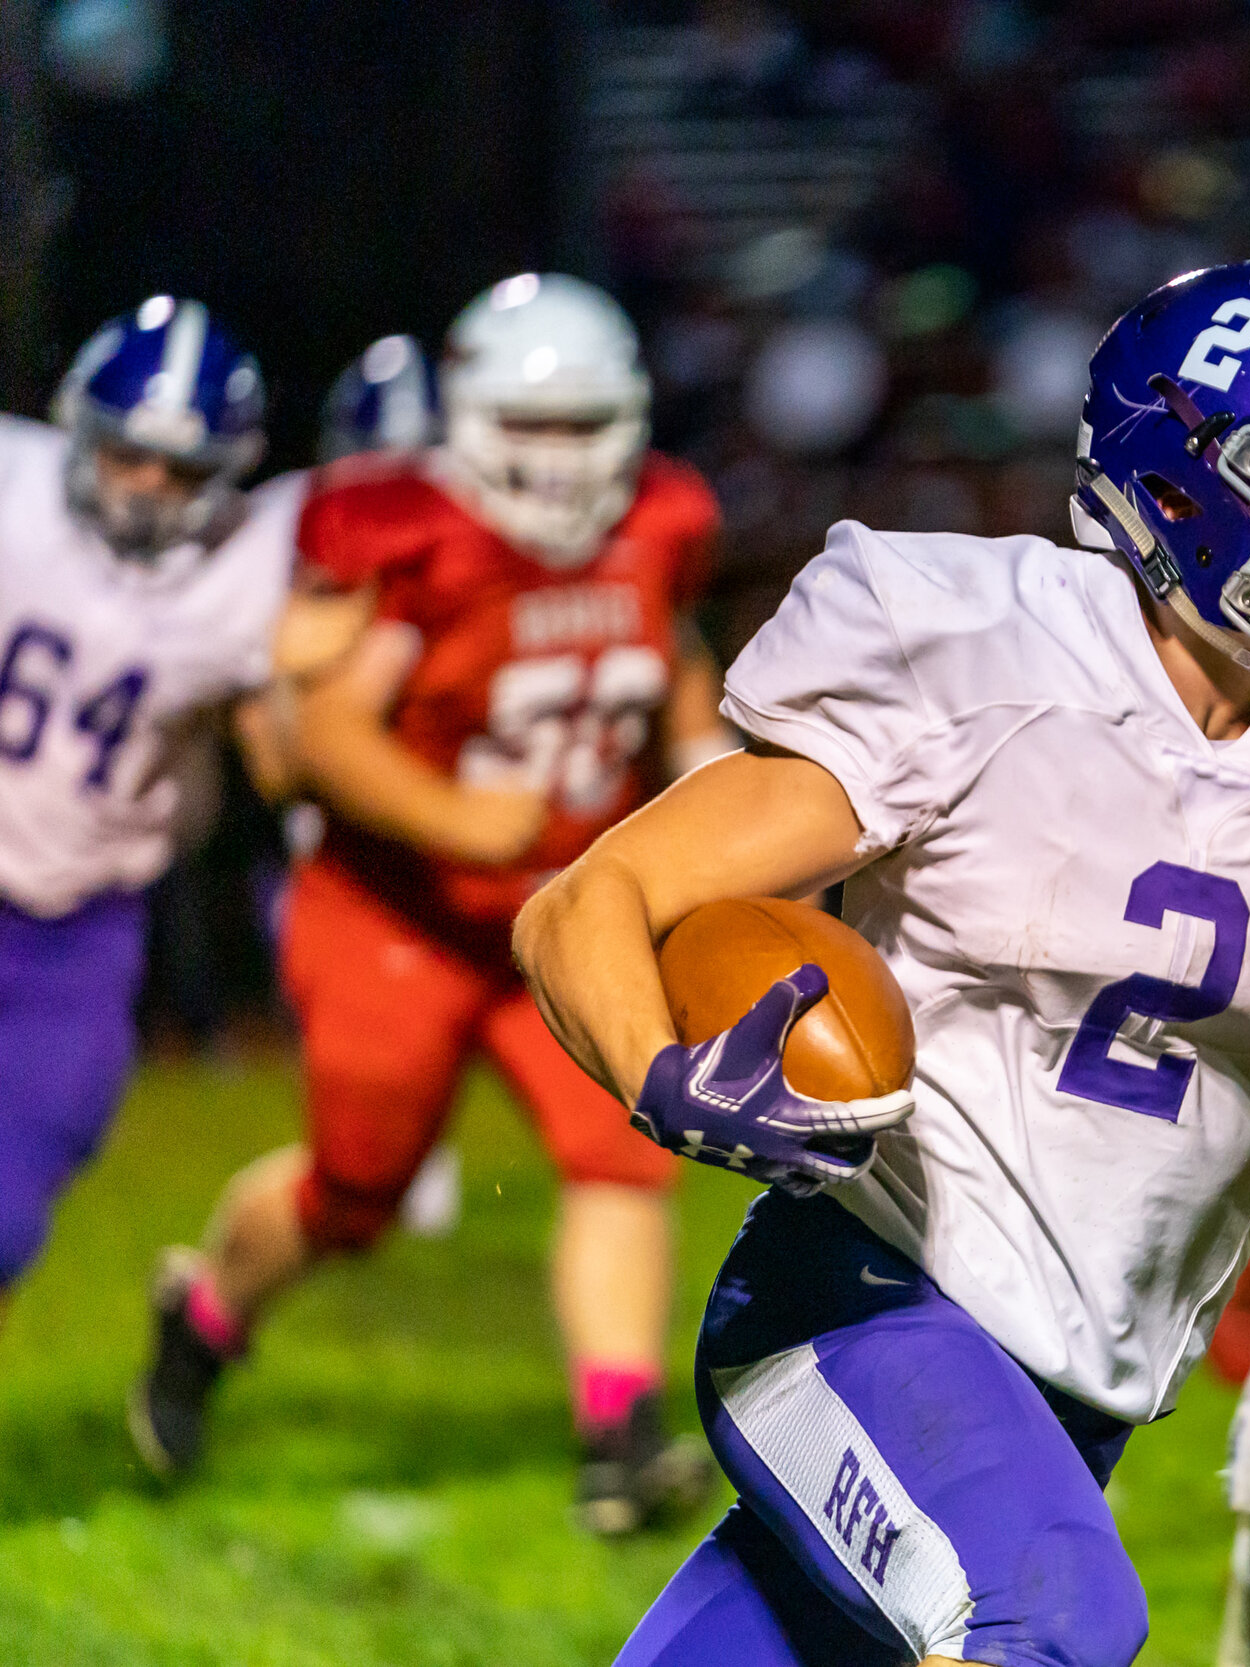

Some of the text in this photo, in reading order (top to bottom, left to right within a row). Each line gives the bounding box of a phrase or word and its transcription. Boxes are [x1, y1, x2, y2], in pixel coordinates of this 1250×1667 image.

[0, 623, 149, 790] 64
[1056, 860, 1250, 1125] 2
[823, 1445, 903, 1588] RFH
